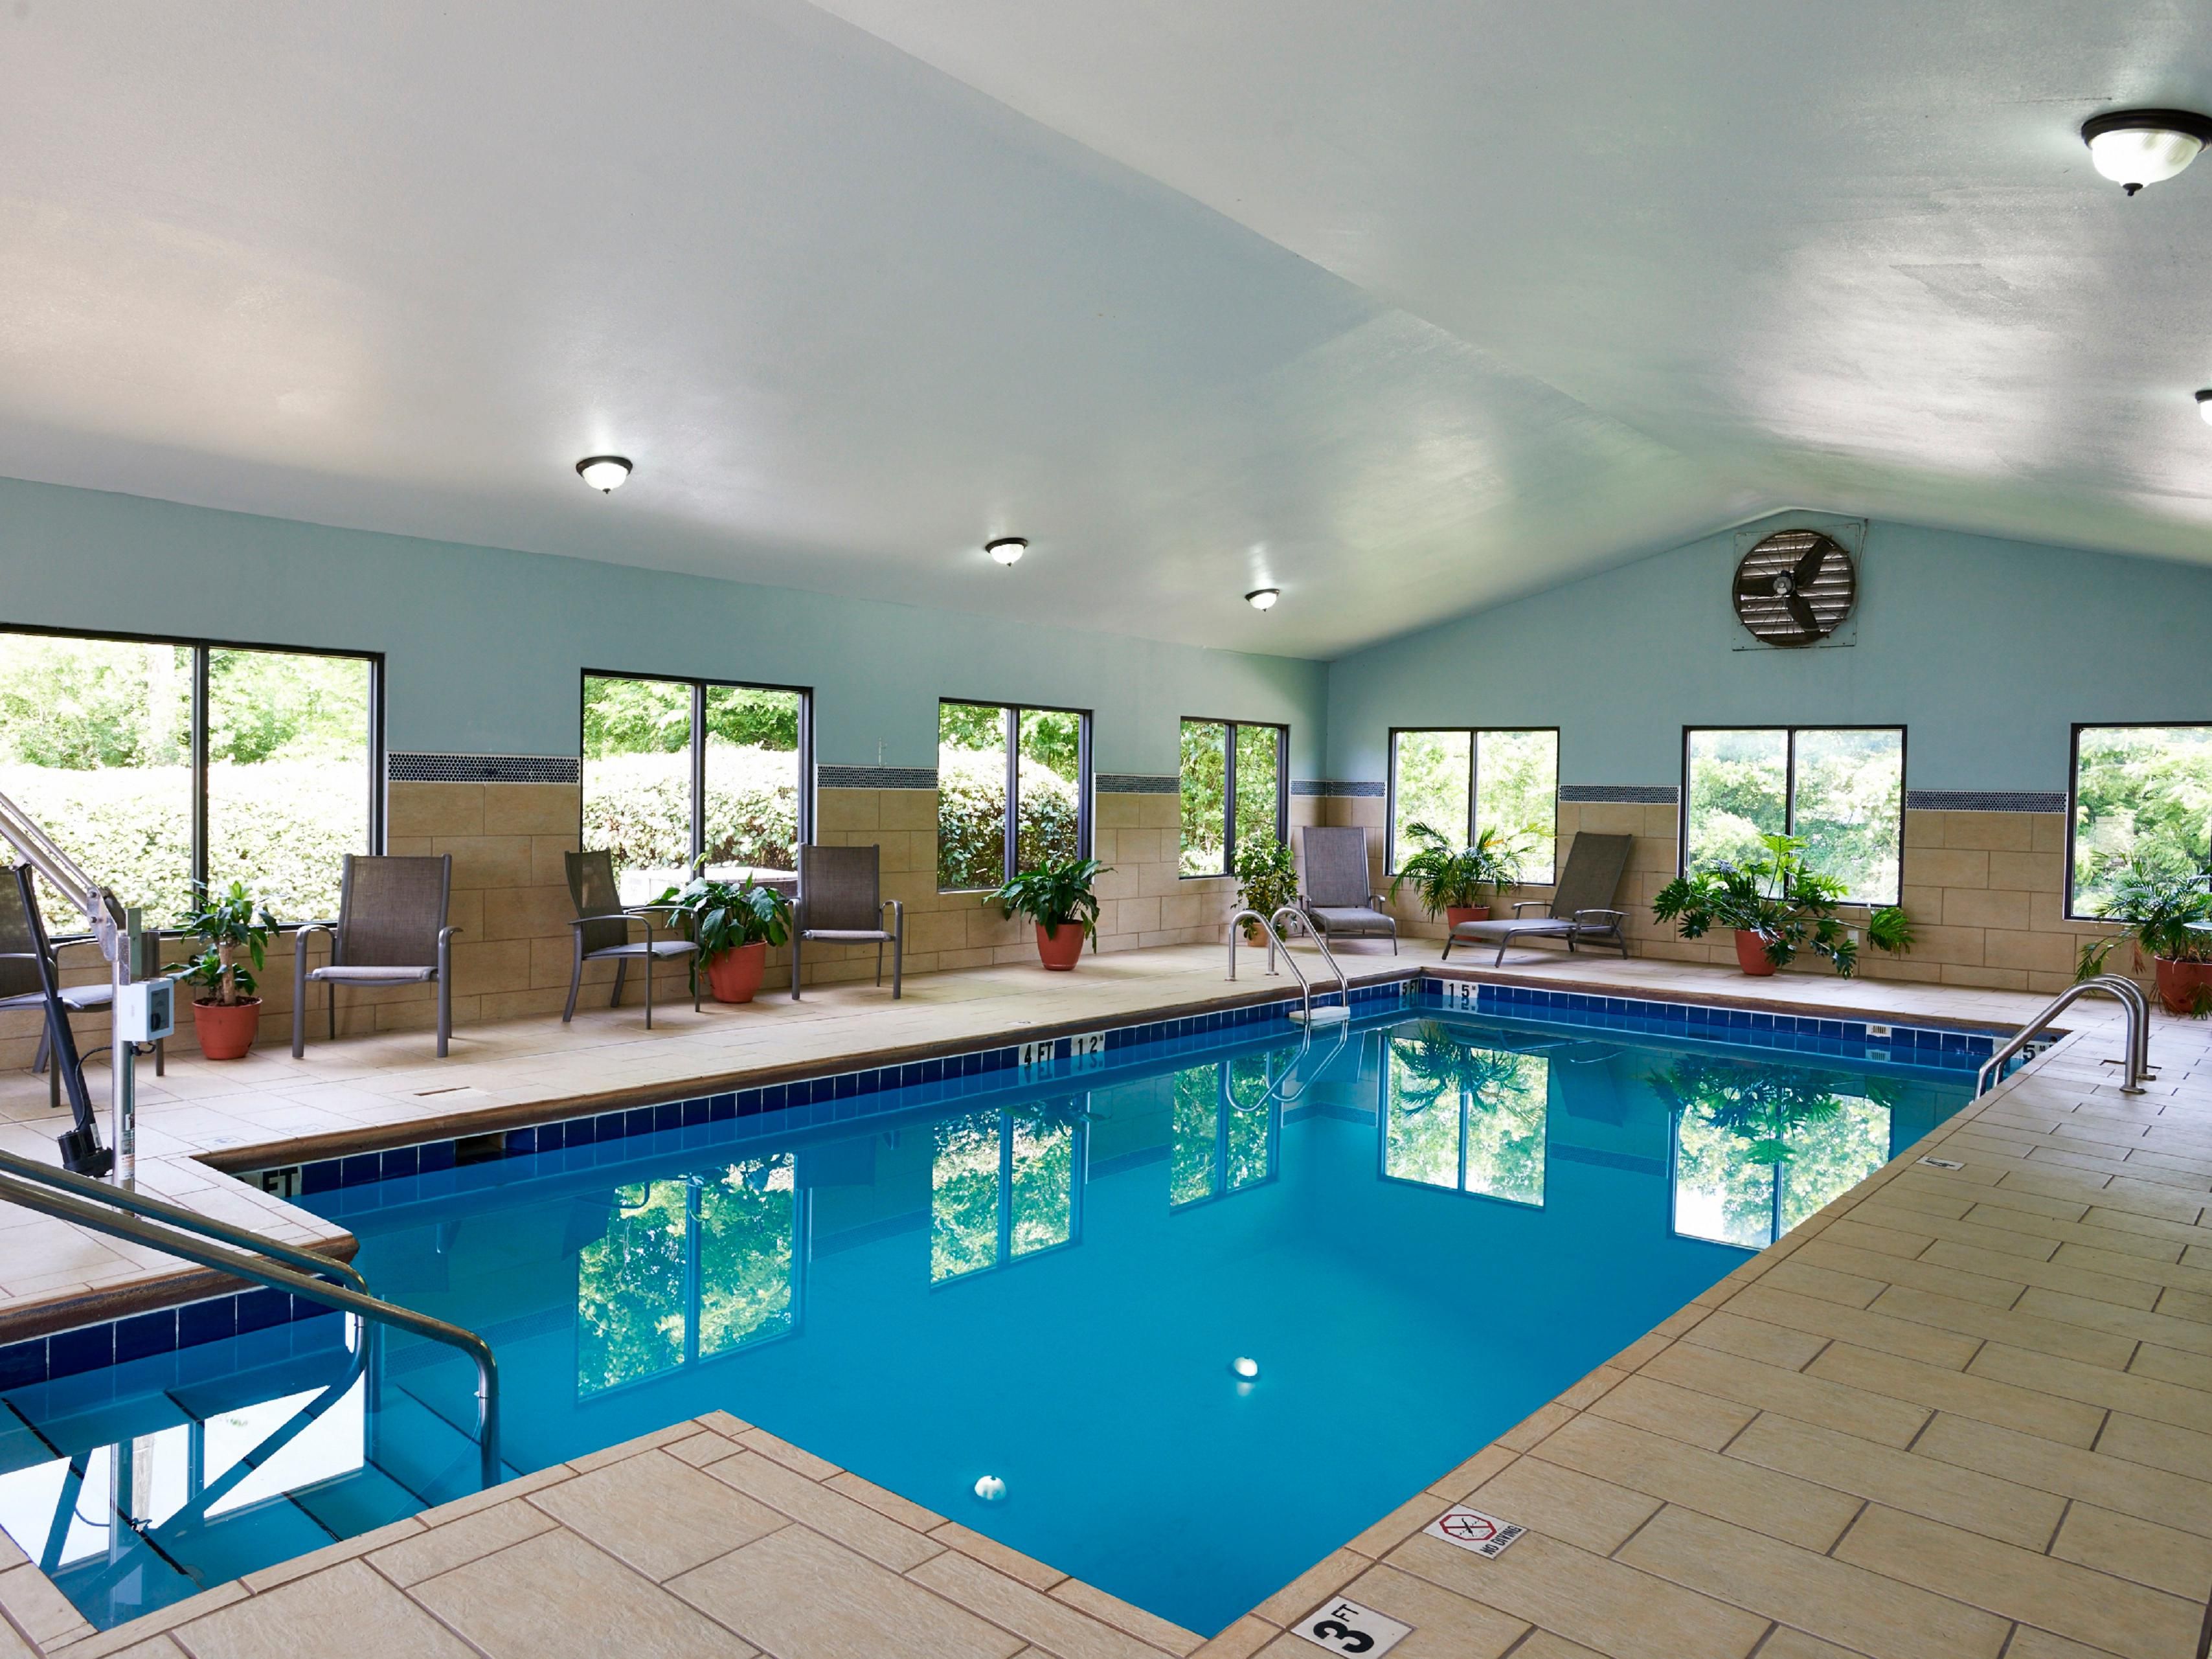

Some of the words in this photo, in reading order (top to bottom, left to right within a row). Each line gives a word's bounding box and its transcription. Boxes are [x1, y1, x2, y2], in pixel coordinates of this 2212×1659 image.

[1024, 1044, 1032, 1065] 4
[1037, 1041, 1054, 1063] FT
[262, 1166, 299, 1198] FT
[1479, 1544, 1499, 1555] NO
[1491, 1526, 1522, 1546] DIVING
[1331, 1603, 1359, 1623] FT
[1313, 1620, 1375, 1653] 3
